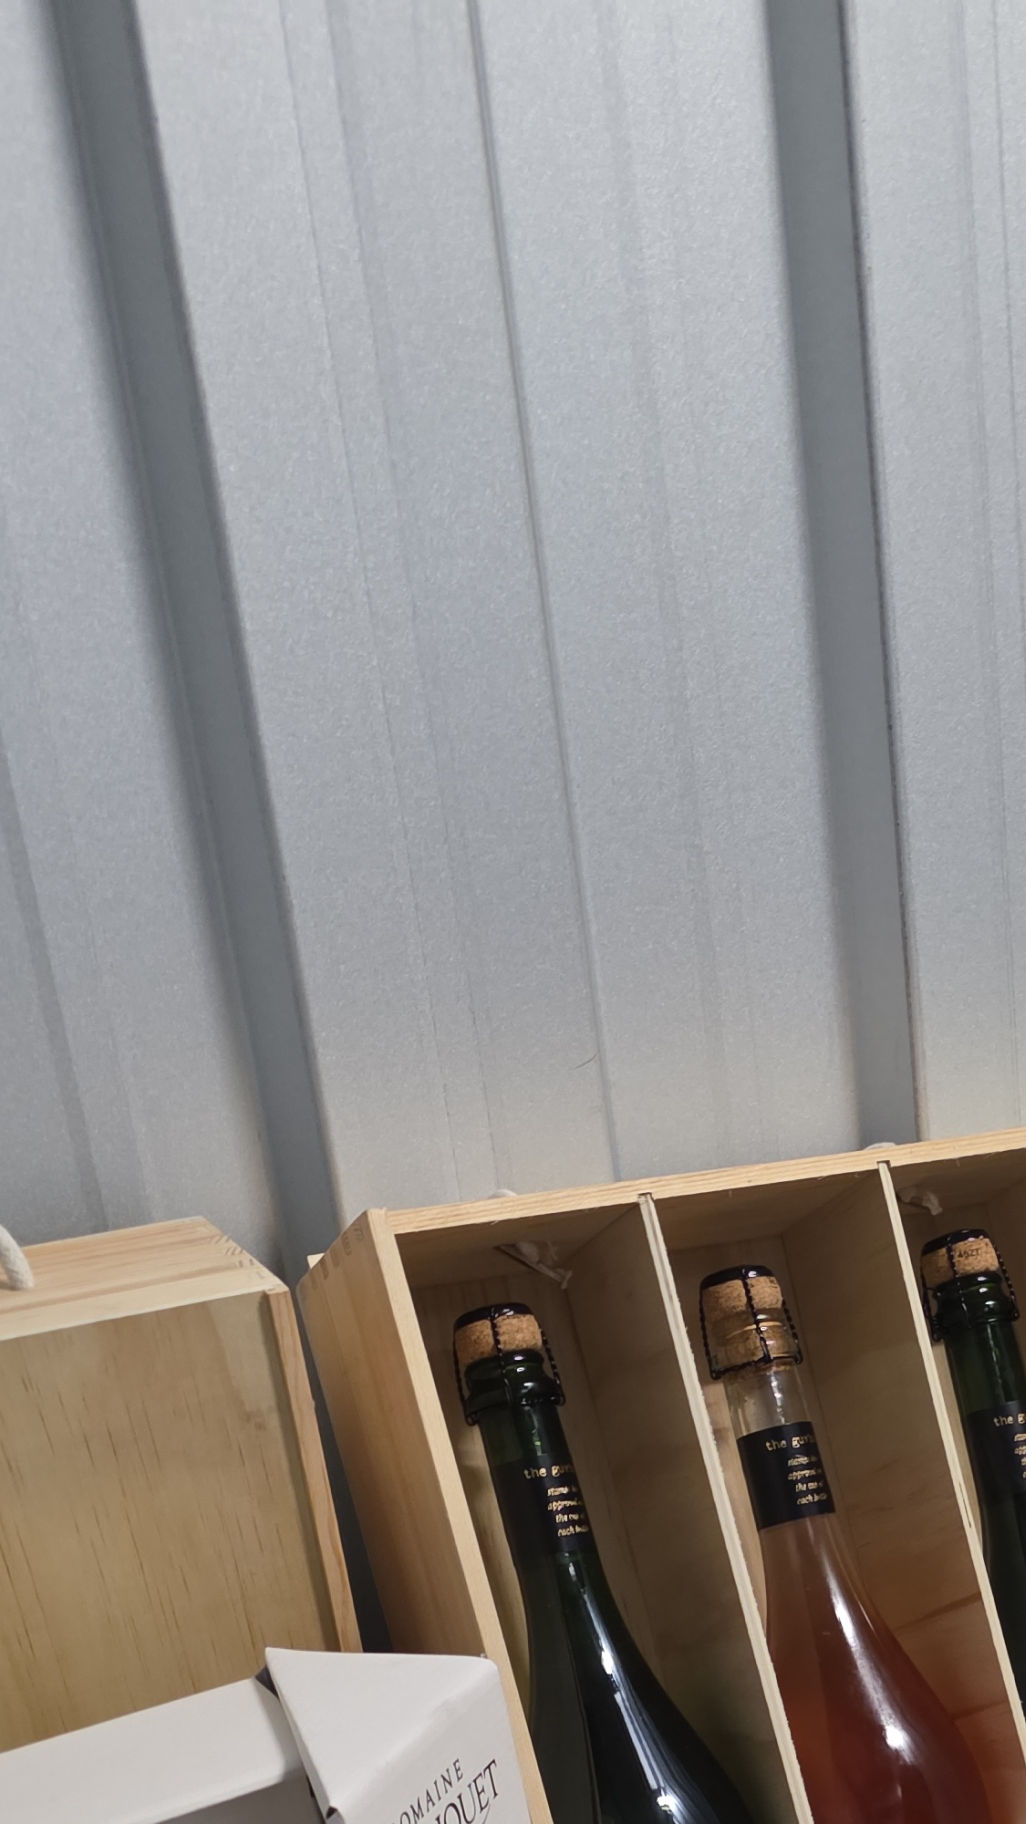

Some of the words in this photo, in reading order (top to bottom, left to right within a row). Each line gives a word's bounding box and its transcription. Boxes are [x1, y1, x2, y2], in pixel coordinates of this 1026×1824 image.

[993, 1415, 1014, 1427] the
[765, 1440, 787, 1451] the
[523, 1467, 547, 1479] the
